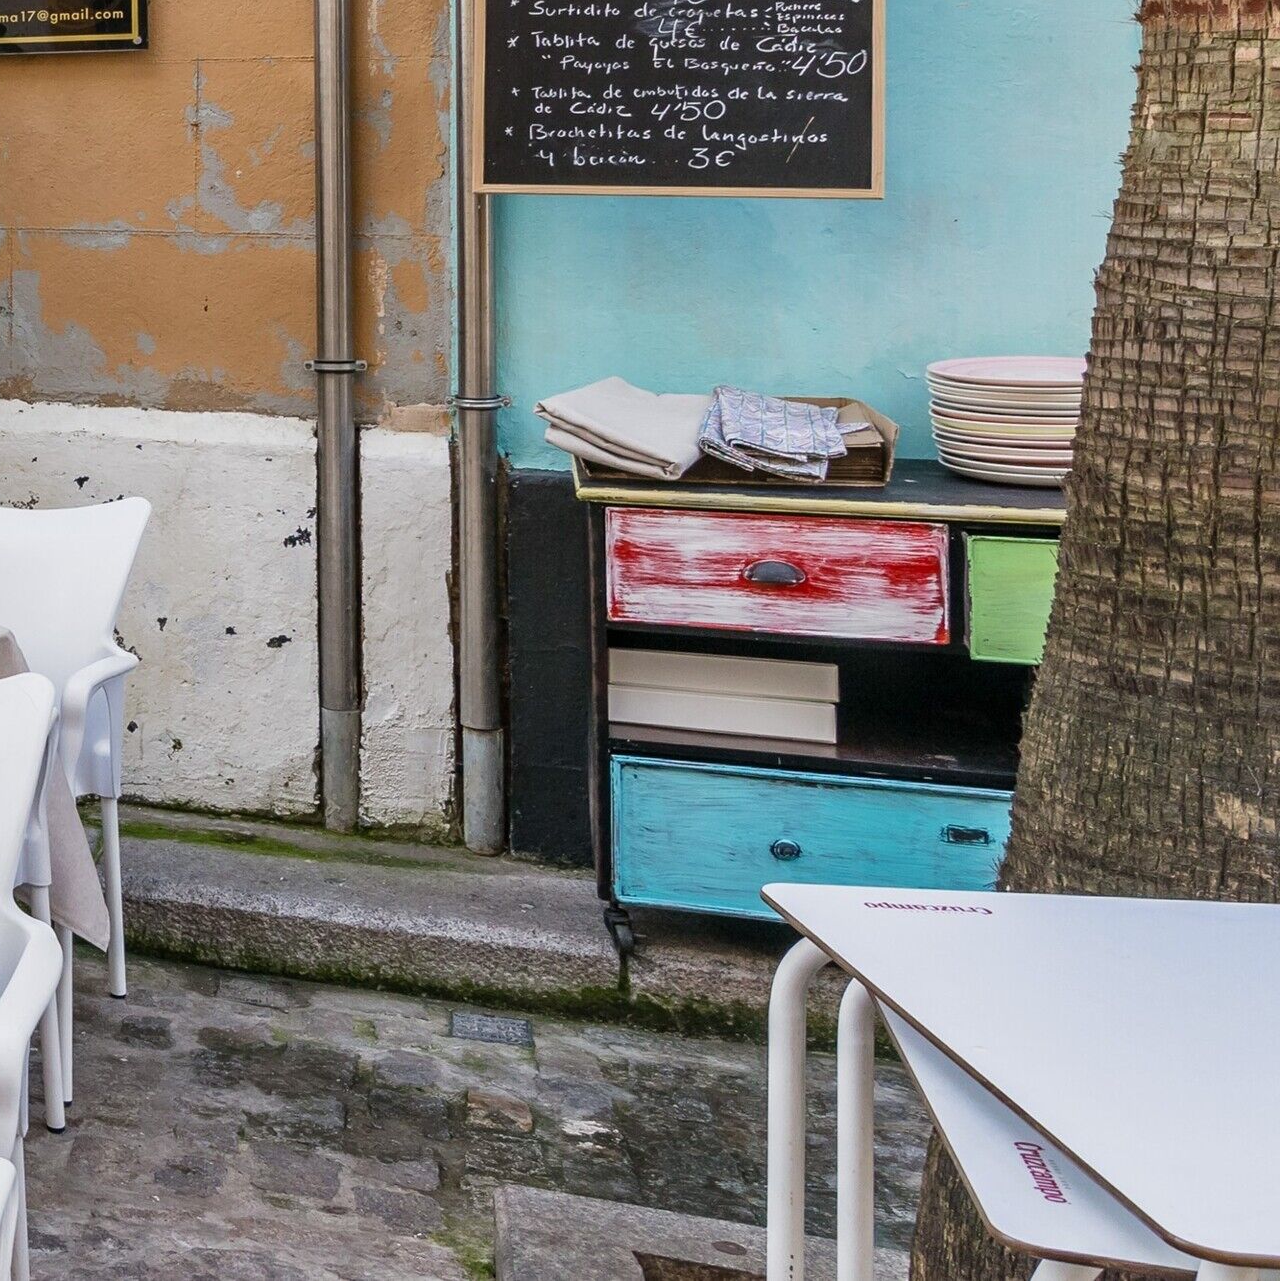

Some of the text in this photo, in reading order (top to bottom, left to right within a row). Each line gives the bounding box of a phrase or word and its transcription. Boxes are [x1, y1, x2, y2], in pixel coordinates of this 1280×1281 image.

[528, 0, 621, 17] Surtidito
[634, 2, 657, 17] de
[668, 3, 759, 25] croquetas
[531, 31, 601, 49] Tablita
[615, 34, 636, 49] de
[720, 36, 740, 51] de
[756, 36, 817, 53] Cádiz
[531, 84, 848, 102] Tablita de embutidos de la sierra
[534, 103, 552, 114] de
[569, 102, 632, 117] Cádiz
[529, 123, 828, 150] Brochetitas de langostinos
[864, 901, 993, 915] Cruzcampo
[1014, 1142, 1067, 1203] Cruzcampo
